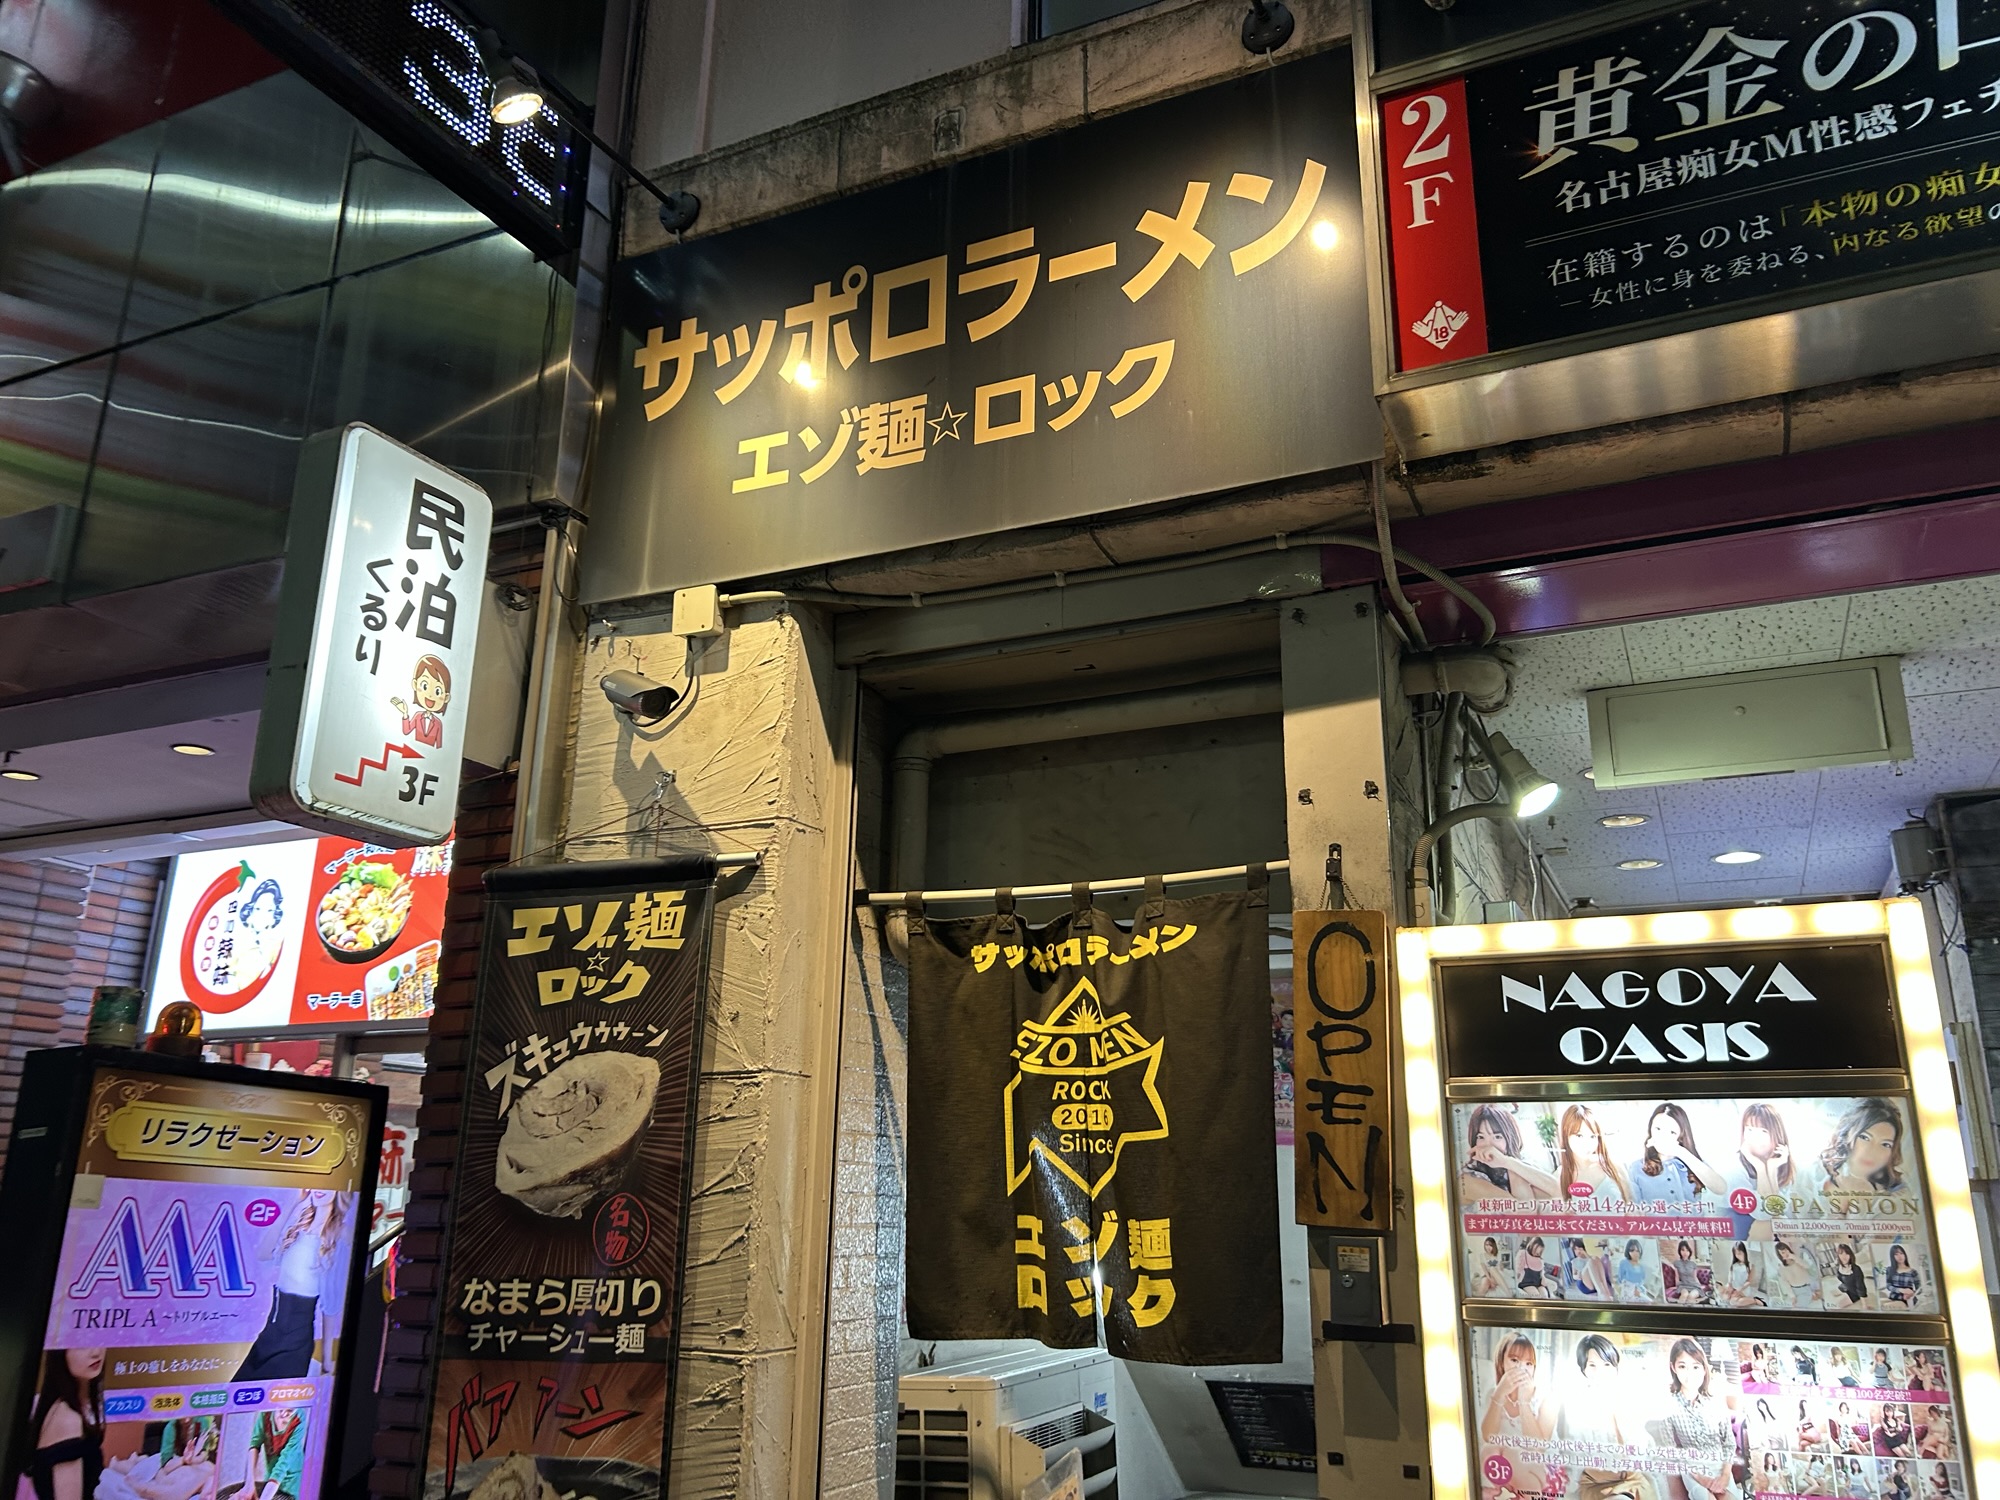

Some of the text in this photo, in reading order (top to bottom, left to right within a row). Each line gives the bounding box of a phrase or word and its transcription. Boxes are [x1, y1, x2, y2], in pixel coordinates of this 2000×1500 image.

[1401, 94, 1454, 230] 2F
[632, 157, 1328, 423] サッポロラーメン
[1433, 326, 1449, 340] 18
[394, 478, 466, 650] 民泊
[354, 557, 394, 676] くるり
[398, 765, 439, 806] 3F
[507, 890, 686, 958] エゾ麺
[970, 923, 1198, 974] サッポロラーメン
[537, 966, 652, 1007] ロック
[1500, 961, 1818, 1014] NAGOYA
[1089, 1022, 1151, 1067] MEN
[1559, 1020, 1770, 1066] OASIS
[1052, 1080, 1112, 1101] ROCK
[1305, 920, 1382, 1222] OPEN
[1060, 1108, 1109, 1126] 2016
[141, 1117, 327, 1160] リラクゼーション
[1059, 1133, 1114, 1154] Since
[249, 1204, 276, 1223] 2F
[1732, 1194, 1755, 1210] 4F
[1791, 1197, 1920, 1217] PASSION
[68, 1196, 256, 1299] AAA
[604, 1198, 630, 1262] 名物
[1014, 1210, 1174, 1271] エゾ麺
[1774, 1222, 1799, 1230] 50min
[1801, 1222, 1841, 1231] 12,000yen
[1872, 1224, 1912, 1232] 17,000yen
[460, 1276, 663, 1318] なまら厚切り
[1016, 1264, 1177, 1328] ロック
[73, 1308, 136, 1329] TRIPL
[141, 1308, 157, 1328] A
[467, 1323, 646, 1356] チャーシュー麺
[270, 1387, 315, 1400] アロマオイル
[1488, 1460, 1510, 1480] 3F
